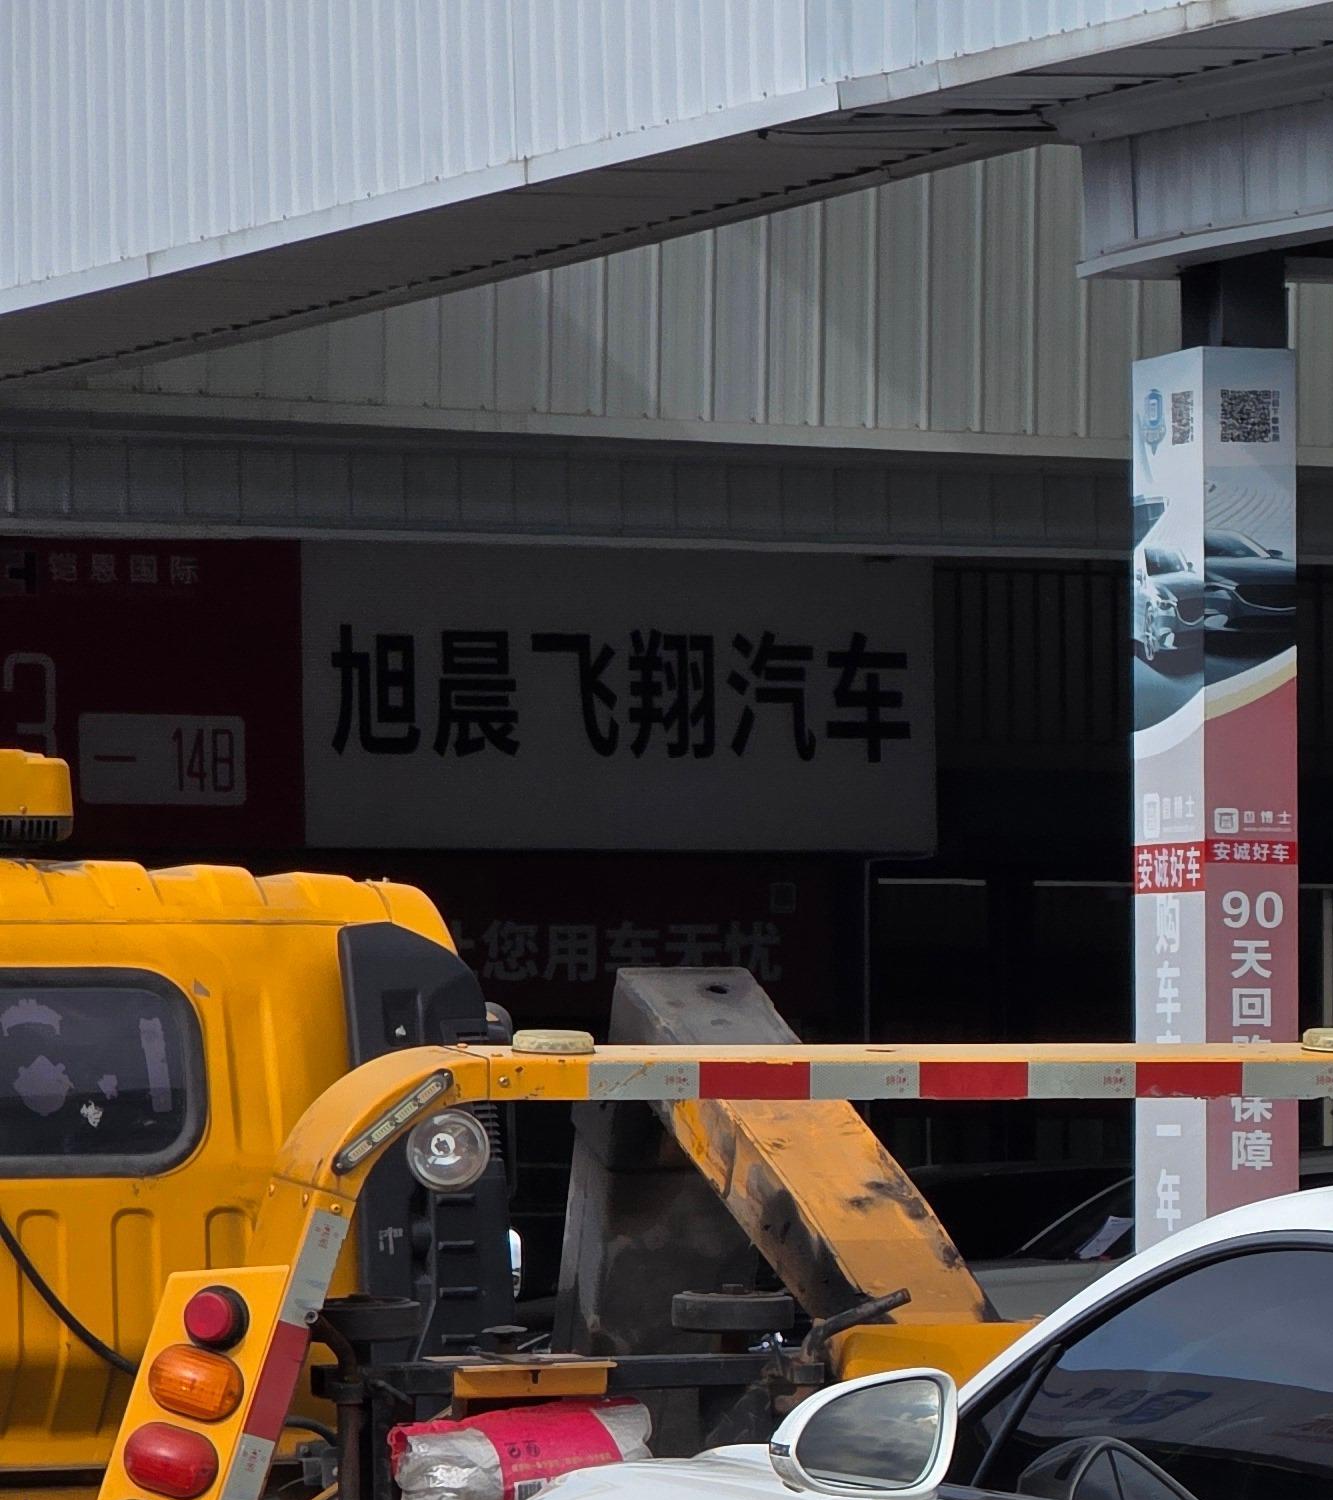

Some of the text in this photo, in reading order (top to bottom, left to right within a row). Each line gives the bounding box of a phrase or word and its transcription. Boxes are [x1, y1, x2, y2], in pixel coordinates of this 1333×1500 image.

[330, 621, 912, 764] 旭晨飞翔汽车
[1137, 846, 1201, 890] 安诚好车
[1212, 841, 1291, 863] 安诚好车
[1221, 889, 1284, 1172] 90天回保障
